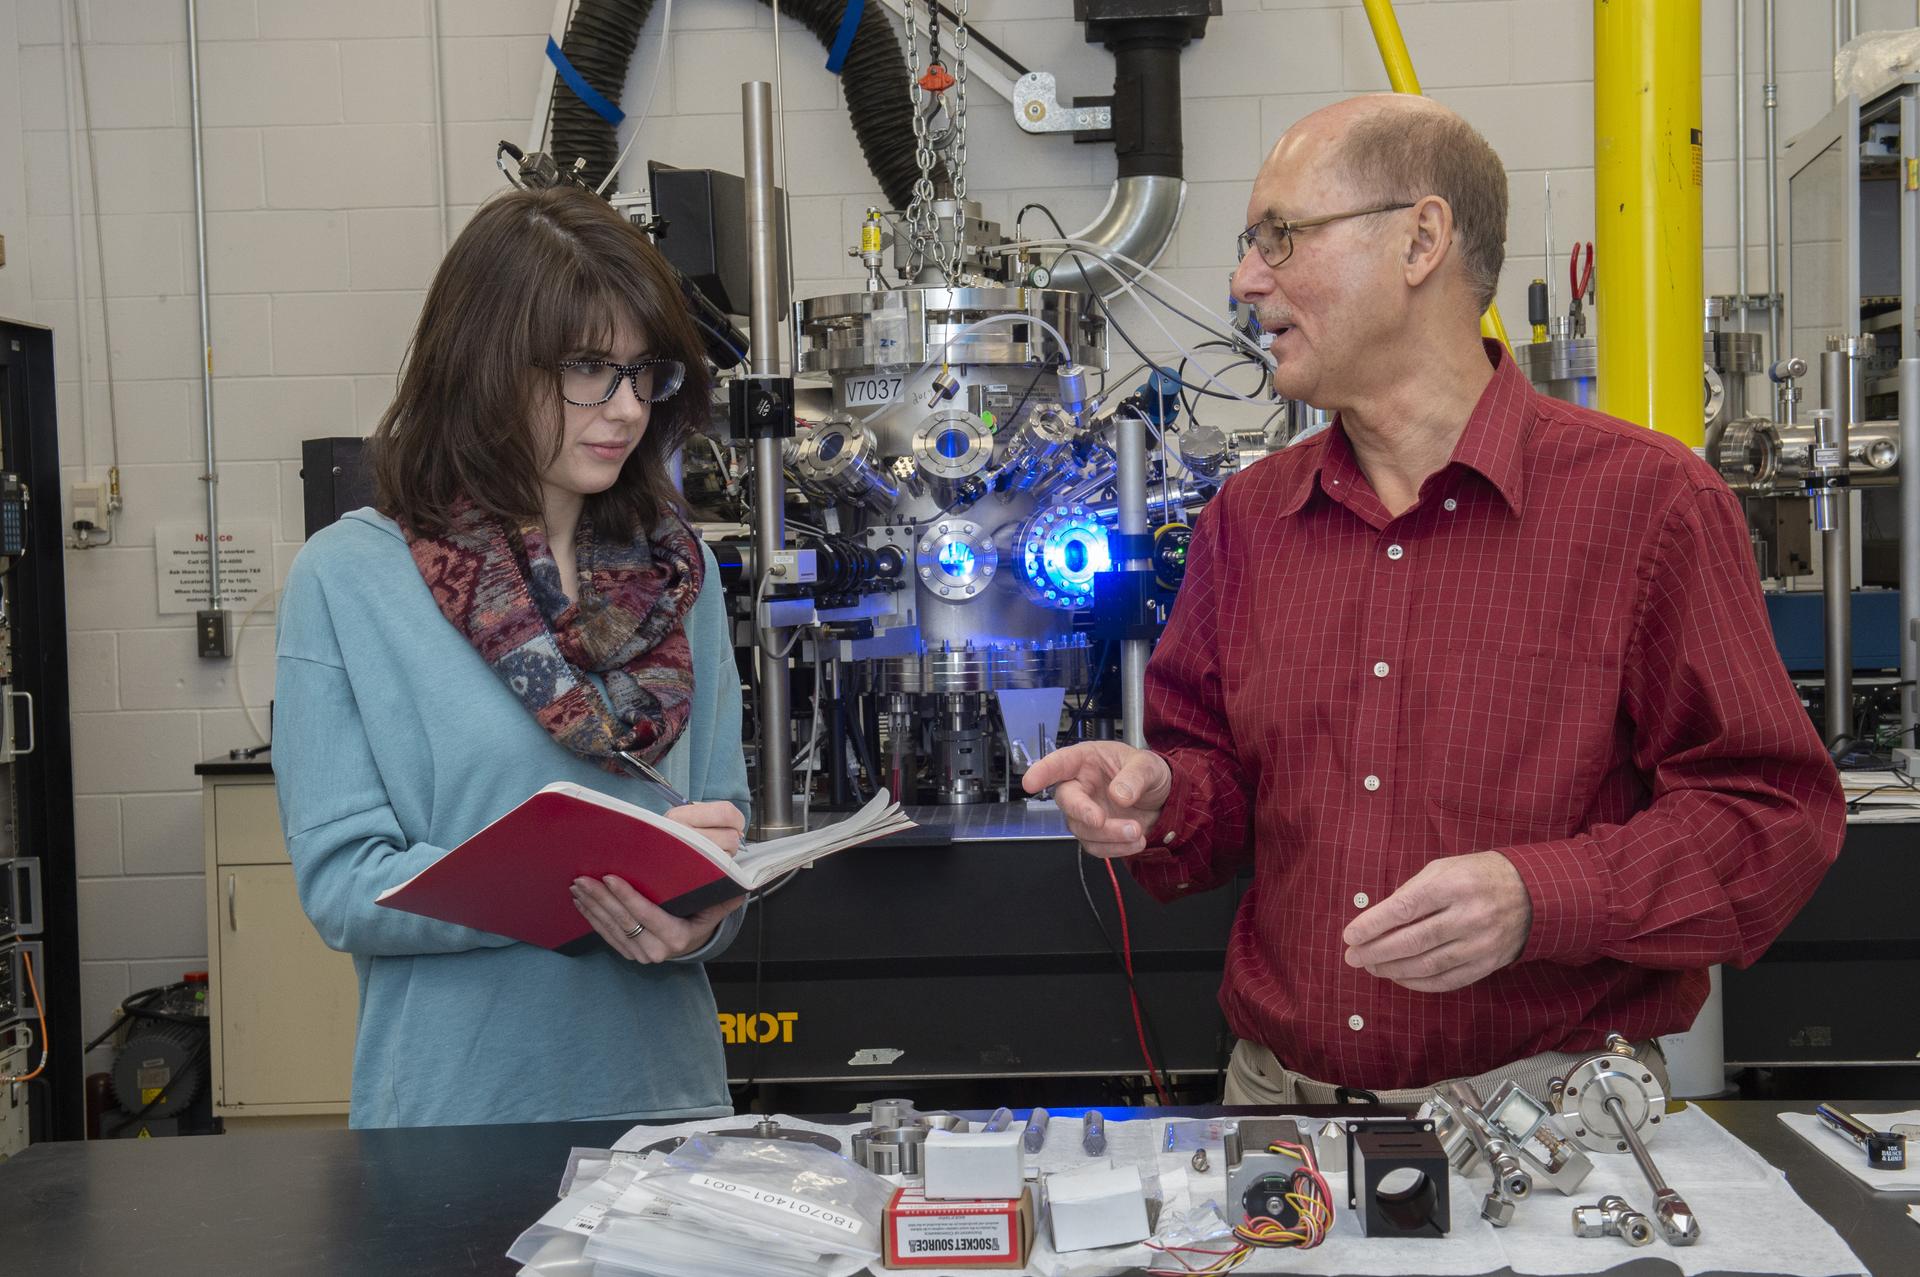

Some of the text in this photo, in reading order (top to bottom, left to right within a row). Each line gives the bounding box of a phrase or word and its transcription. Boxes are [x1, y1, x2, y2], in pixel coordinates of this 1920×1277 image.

[846, 378, 902, 402] V7037
[195, 533, 233, 542] Noce
[916, 1238, 992, 1252] SOCKET SOURCE
